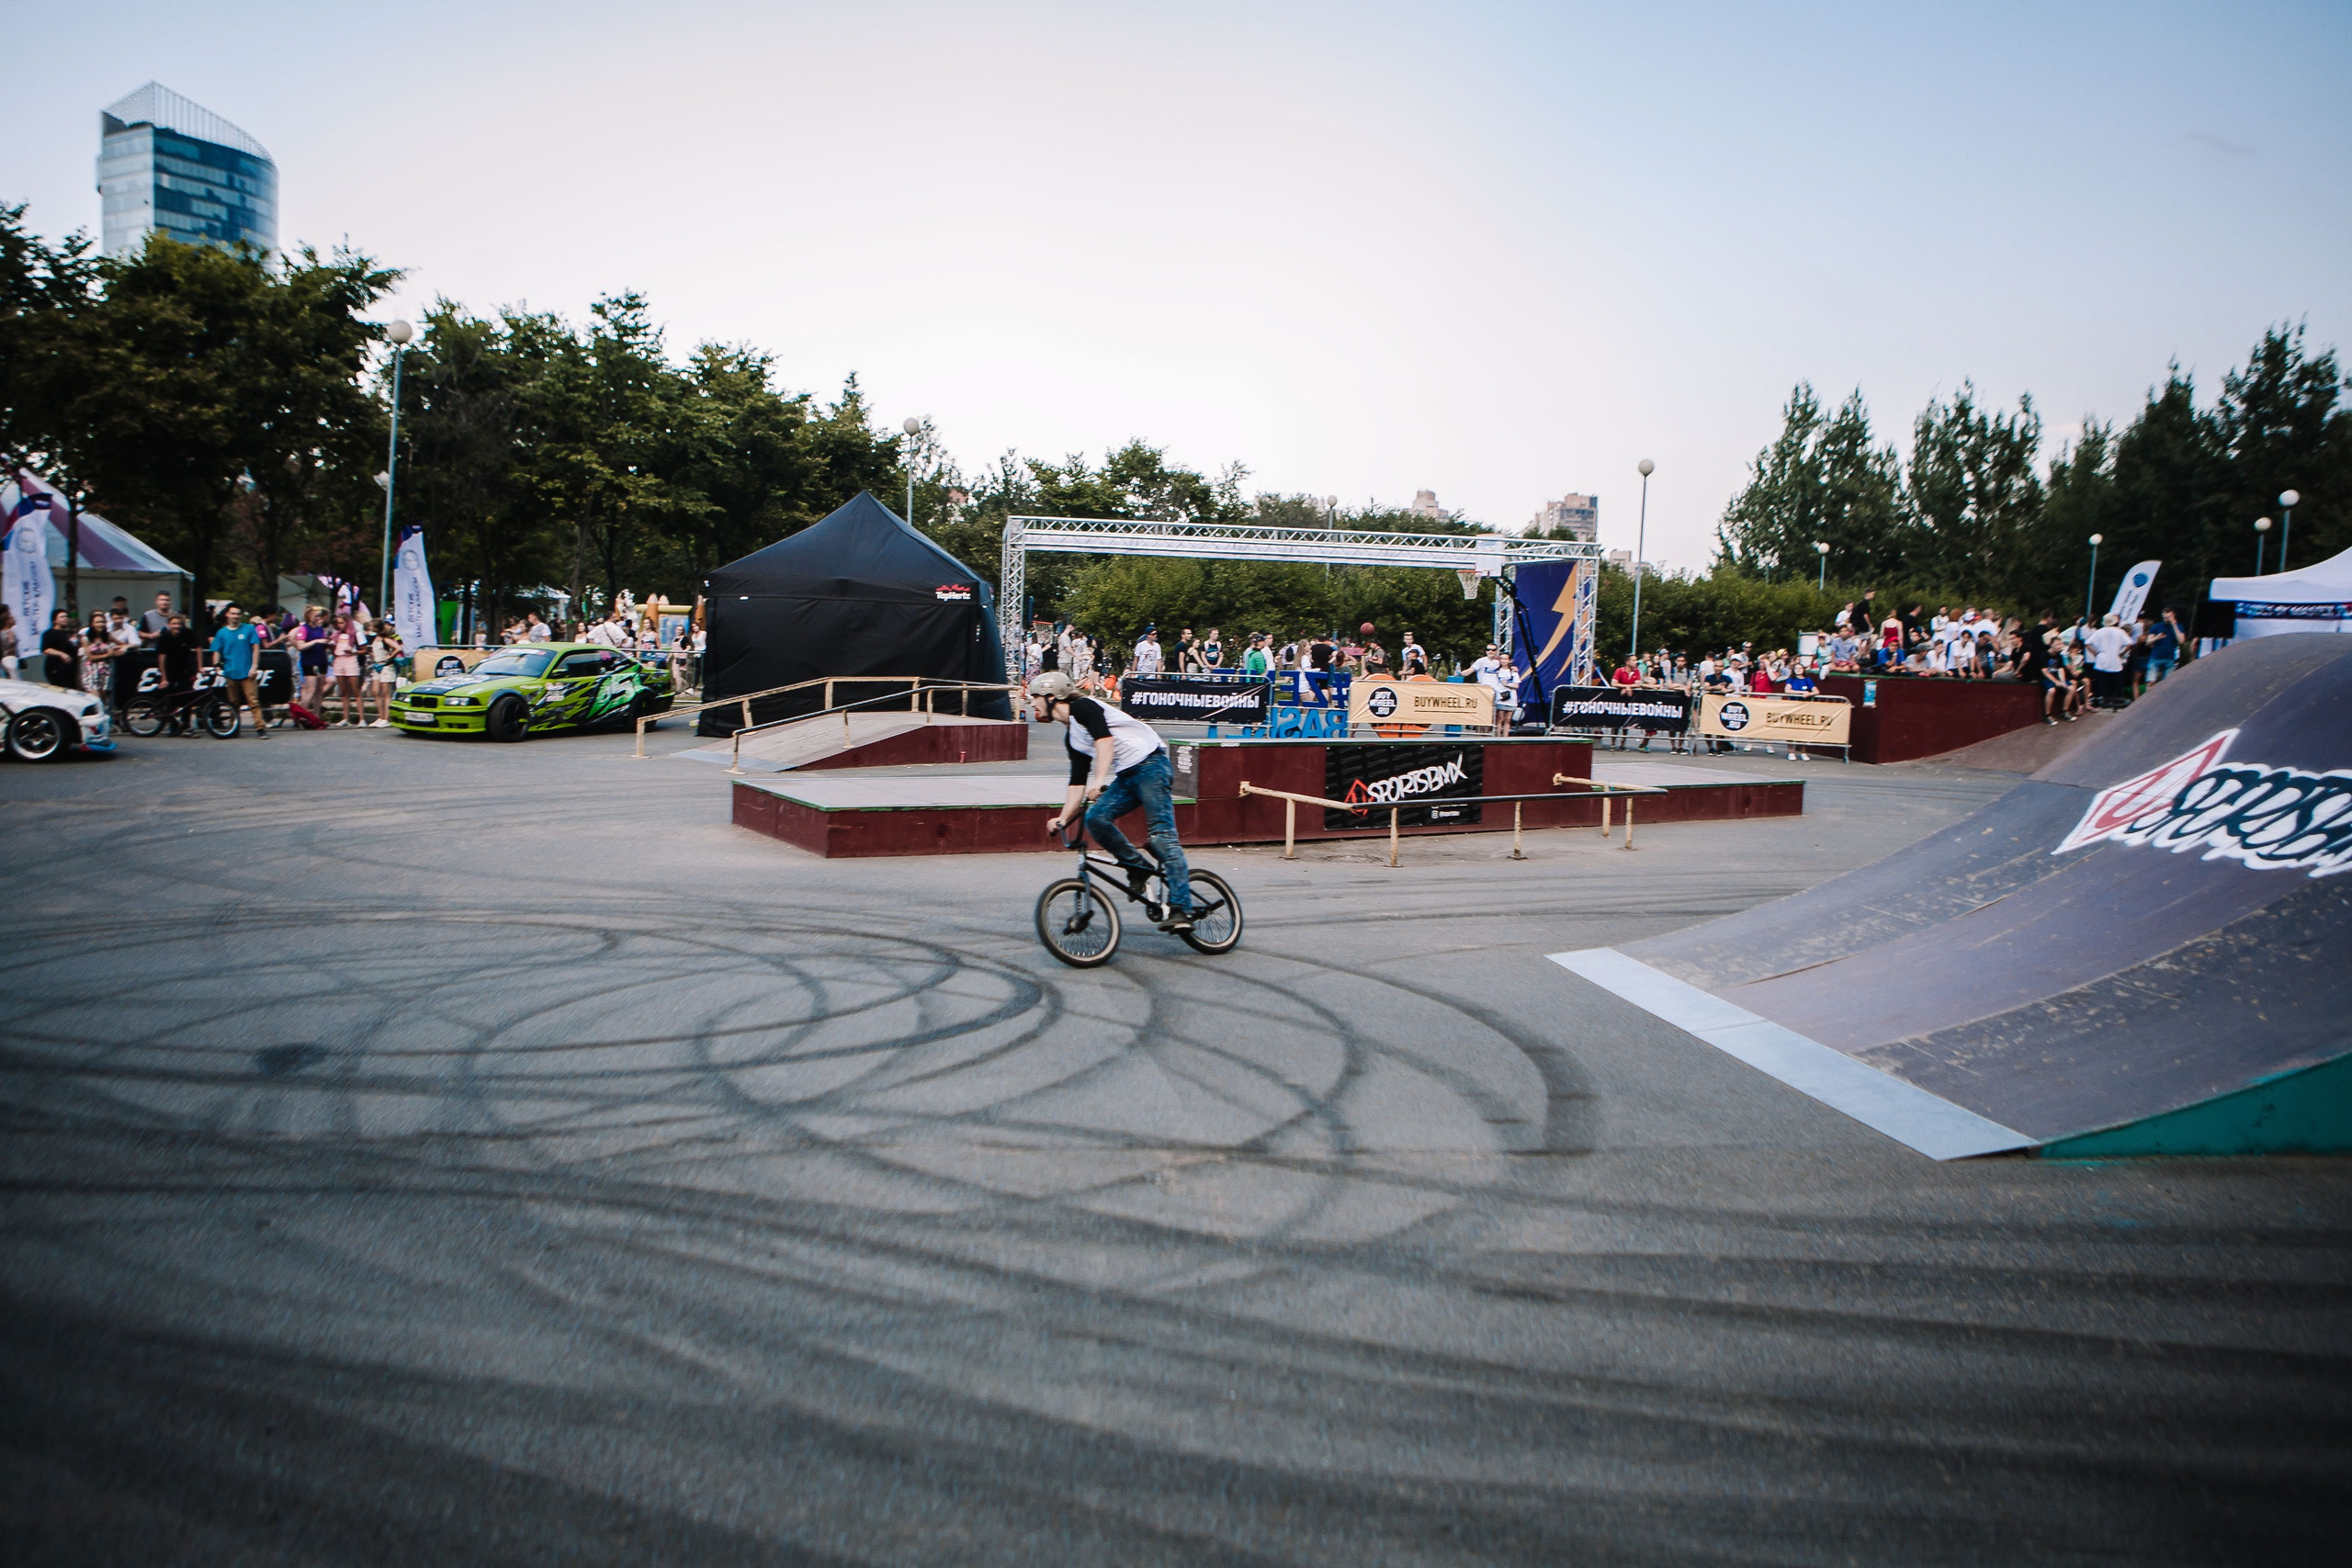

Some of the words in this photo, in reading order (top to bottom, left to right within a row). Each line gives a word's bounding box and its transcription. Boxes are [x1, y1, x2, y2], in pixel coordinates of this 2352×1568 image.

[1130, 691, 1260, 708] #ГОНОЧНЫЕВОЙНЫ
[1374, 691, 1392, 699] BUY
[1369, 699, 1396, 707] WHEEL
[1414, 696, 1477, 709] BUYWHEEL.RU
[1562, 701, 1683, 718] #ГОНОЧНЫЕВОЙНЫ
[1726, 705, 1743, 714] BUY
[1720, 713, 1747, 722] WHEEL
[1766, 712, 1834, 727] BUYWHEEL.RU
[1366, 751, 1468, 802] SPORTSBMX
